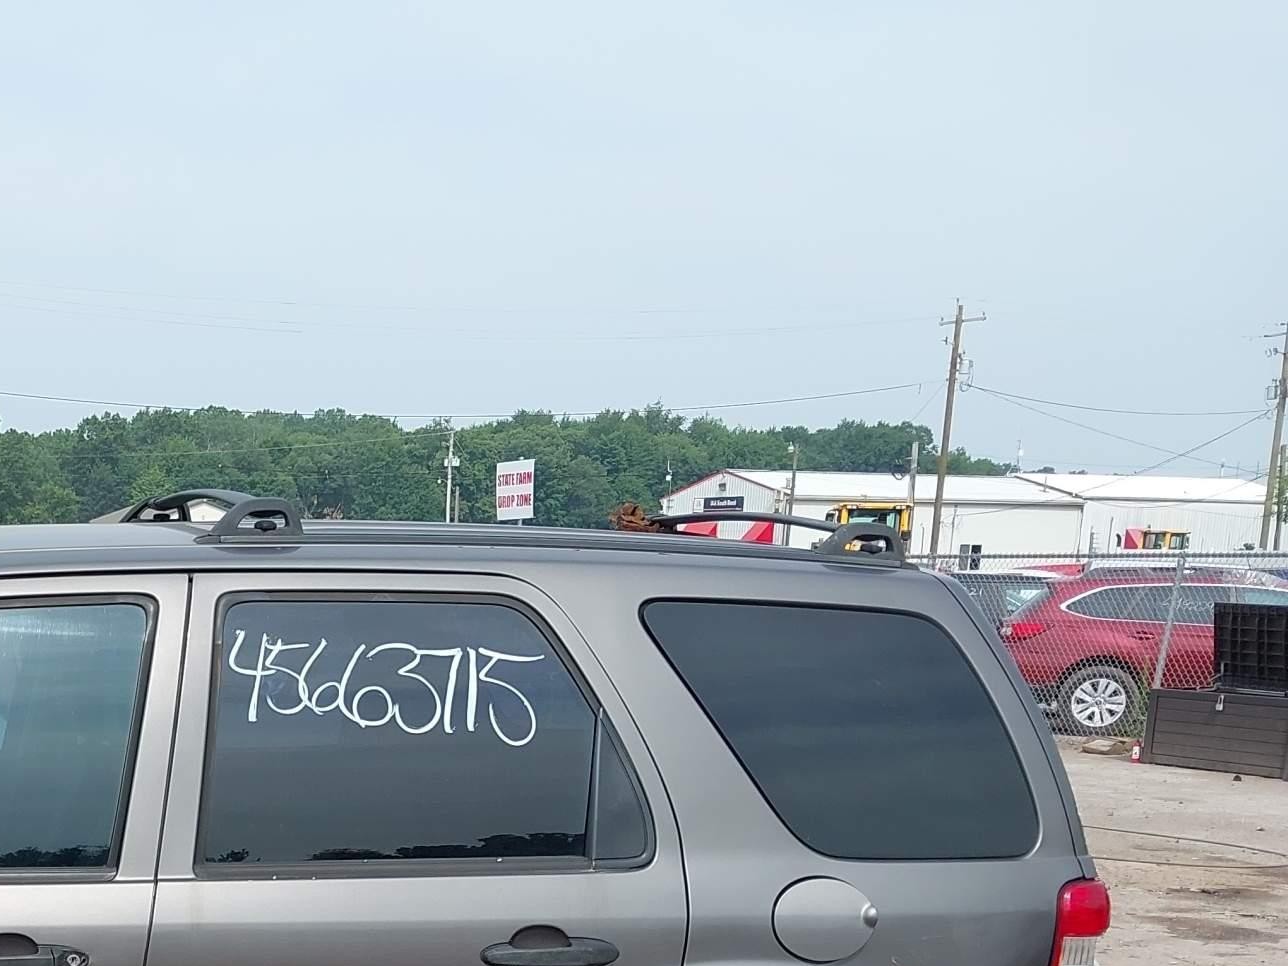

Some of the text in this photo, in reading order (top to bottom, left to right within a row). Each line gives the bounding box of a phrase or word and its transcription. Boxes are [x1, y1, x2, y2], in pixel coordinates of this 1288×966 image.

[497, 471, 533, 487] STATE FARM
[498, 493, 532, 508] DROP ZONE
[228, 629, 545, 746] 45663715
